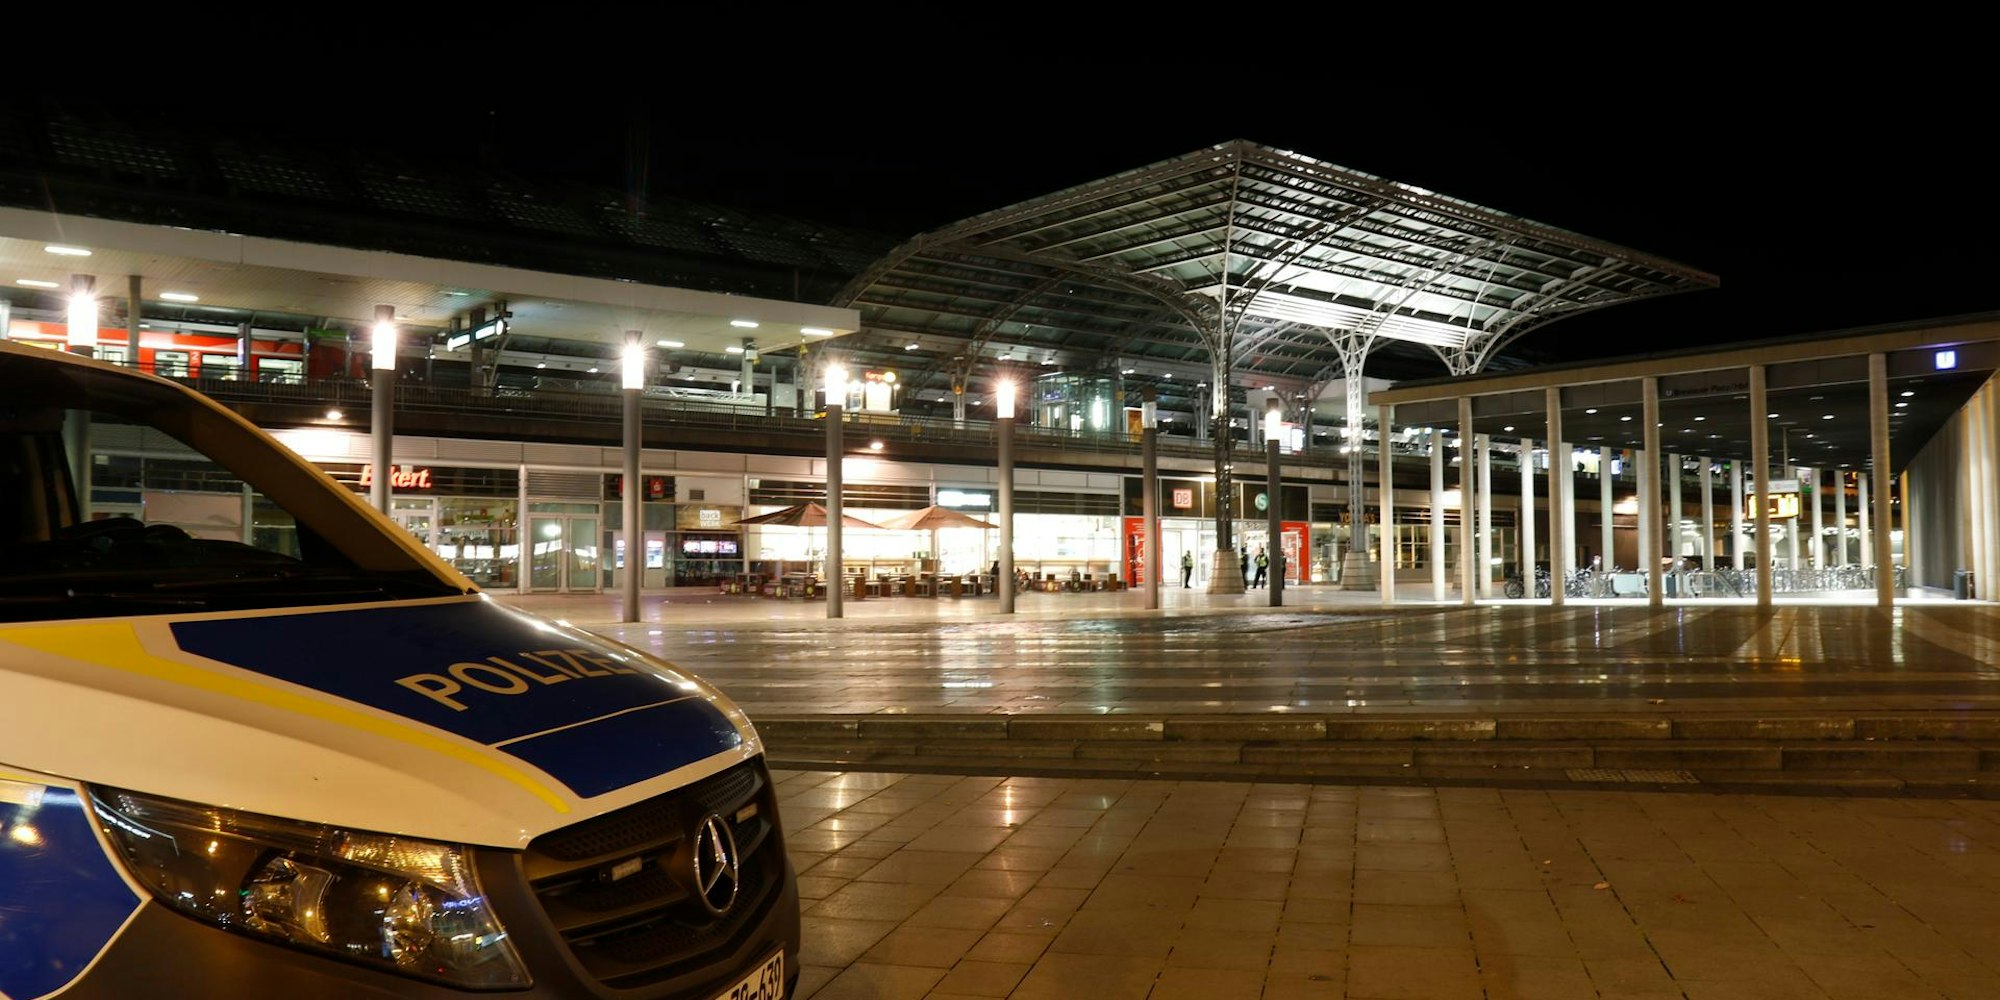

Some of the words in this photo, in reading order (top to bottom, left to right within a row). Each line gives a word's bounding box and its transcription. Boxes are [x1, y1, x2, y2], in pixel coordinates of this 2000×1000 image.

[1936, 351, 1956, 369] U
[360, 464, 432, 488] Ekert.
[1175, 491, 1190, 506] DB
[394, 649, 646, 712] POLIZE
[731, 956, 781, 1000] -639
